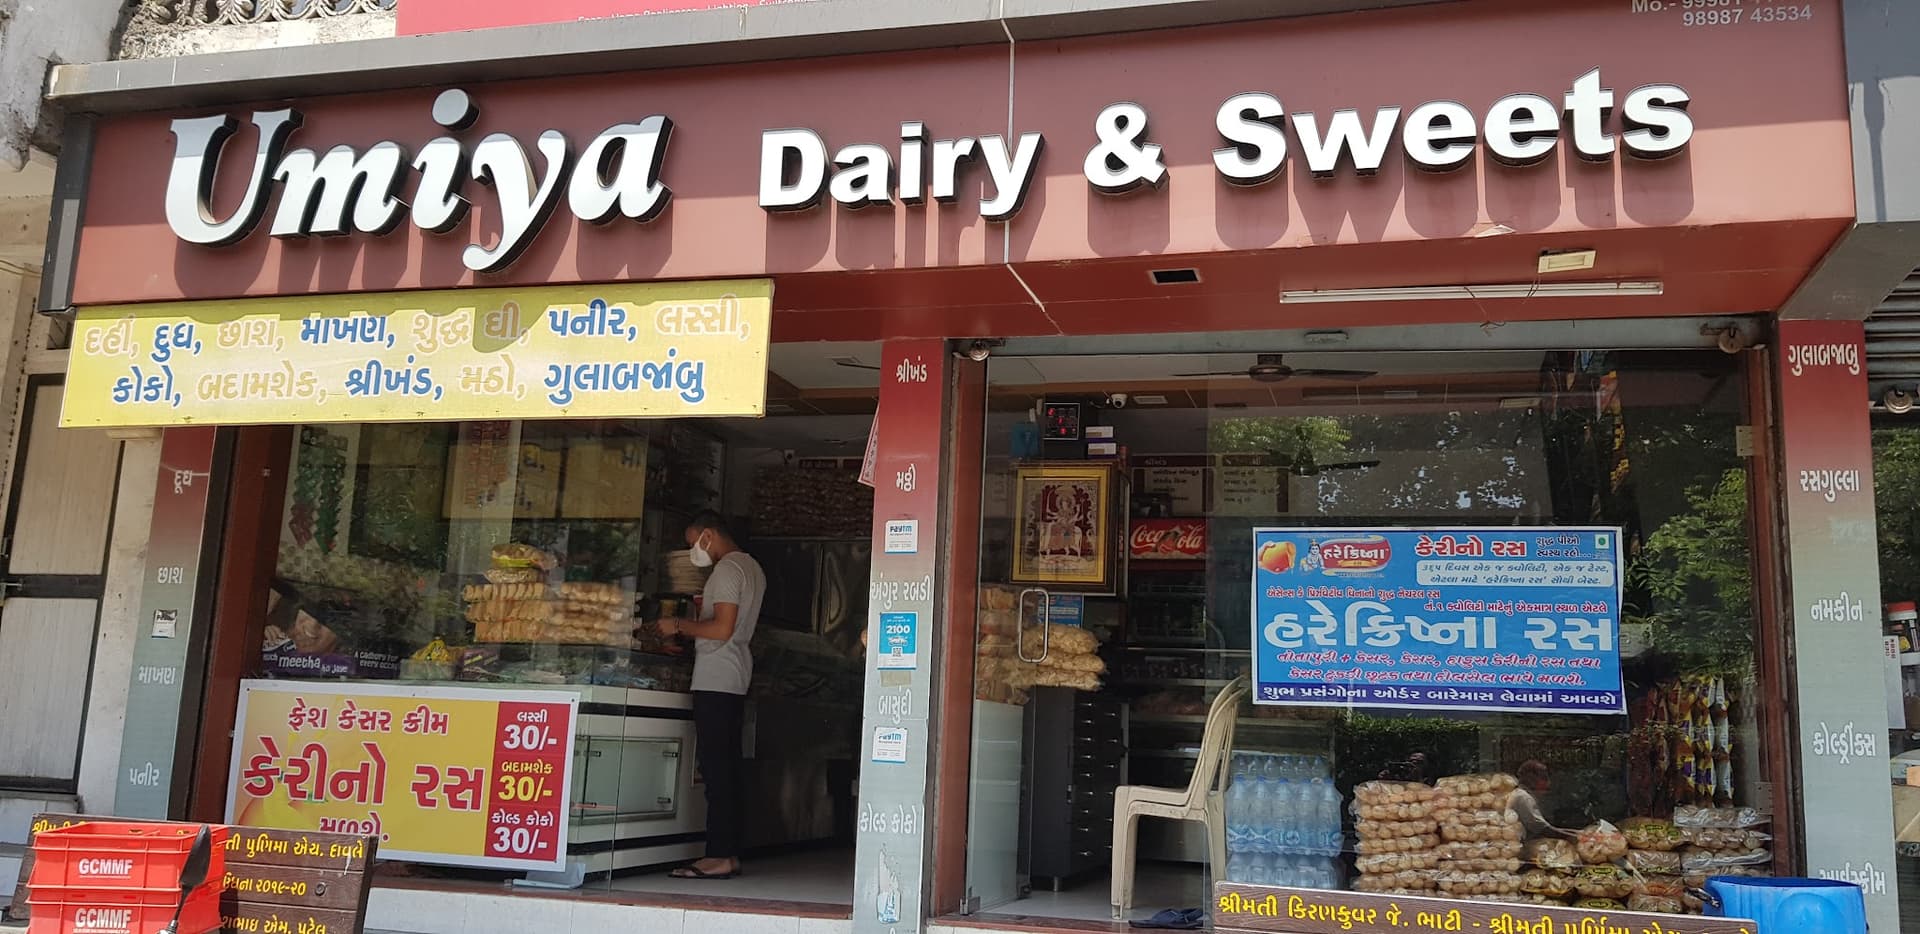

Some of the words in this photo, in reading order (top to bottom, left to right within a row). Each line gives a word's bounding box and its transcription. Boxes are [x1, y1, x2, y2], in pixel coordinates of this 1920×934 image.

[1683, 9, 1743, 26] 98987
[1750, 5, 1813, 23] 43534
[164, 87, 674, 274] Umiya
[758, 120, 1044, 221] Dairy
[1082, 102, 1170, 194] &
[1212, 66, 1695, 188] Sweets
[151, 323, 201, 362] દુધ,
[218, 320, 284, 352] છાશ,
[301, 316, 396, 350] માખણ,
[484, 302, 530, 344] ઘી,
[549, 298, 637, 341] પનીર,
[656, 294, 750, 341] લસ્સી,
[113, 365, 182, 407] કોકો,
[197, 360, 327, 405] બદામશેક,
[345, 355, 443, 400] શ્રીખંડ,
[459, 355, 526, 398] મઠો,
[544, 348, 706, 405] ગુલાબજાંબુ
[896, 356, 928, 383] શ્રીખંડ
[174, 469, 193, 495] દૂધ
[1800, 469, 1860, 502] રસગુલ્લા
[1415, 535, 1483, 557] કેરીનો
[1491, 540, 1527, 557] રસ
[157, 566, 183, 586] છાશ
[1445, 562, 1470, 572] દિવસ
[1473, 563, 1491, 571] એક
[1553, 563, 1571, 572] એક
[1461, 574, 1478, 583] માટે
[872, 572, 898, 610] અંગુર
[903, 575, 931, 601] રબડી
[1297, 585, 1304, 598] કે
[1346, 586, 1375, 598] વિનાનો
[1427, 589, 1440, 599] રસ
[1555, 603, 1579, 613] સ્થળ
[1582, 600, 1608, 613] એટલે
[1810, 592, 1863, 622] નમકીન
[1524, 617, 1613, 651] રસ
[278, 655, 321, 669] meetha
[1354, 651, 1395, 666] કેસર,
[1400, 651, 1441, 667] કેસર,
[1491, 653, 1537, 668] કેરીનો
[1540, 657, 1565, 668] રસ
[1568, 657, 1601, 670] તથા
[138, 665, 176, 686] માખણ
[1288, 666, 1322, 679] કેસર
[1402, 671, 1432, 682] તથા
[1499, 671, 1534, 685] ભાવે
[878, 685, 912, 724] બાસુંદી
[1264, 687, 1295, 699] શુભ
[1301, 685, 1366, 698] પ્રસંગોના
[1373, 686, 1421, 699] ઓર્ડર
[1426, 688, 1494, 701] બારેમાસ
[1500, 690, 1552, 703] લેવામાં
[1560, 692, 1616, 705] આવશે
[338, 701, 392, 732] કેસર
[517, 709, 548, 723] લસ્સી
[503, 725, 557, 751] 30/-
[129, 762, 160, 787] પનીર
[243, 736, 387, 805] કેરીનો
[410, 765, 486, 811] રસ
[502, 758, 553, 774] બદામશેક
[498, 775, 552, 802] 30/-
[491, 810, 520, 825] કોલ્ડ
[526, 811, 554, 826] કોકો
[860, 802, 887, 834] કોલ્ડ
[890, 804, 918, 834] કોકો
[293, 837, 323, 857] એચ.
[492, 827, 548, 854] 30/-
[79, 858, 133, 875] GCMMF
[256, 879, 307, 896] ૨૦૧૯-૨૦
[75, 907, 133, 928] GCMMF
[1218, 892, 1278, 917] શ્રીમતી
[1288, 895, 1377, 930] કિરણકુવર
[1385, 904, 1409, 928] જે.
[1417, 909, 1461, 931] ભાટી
